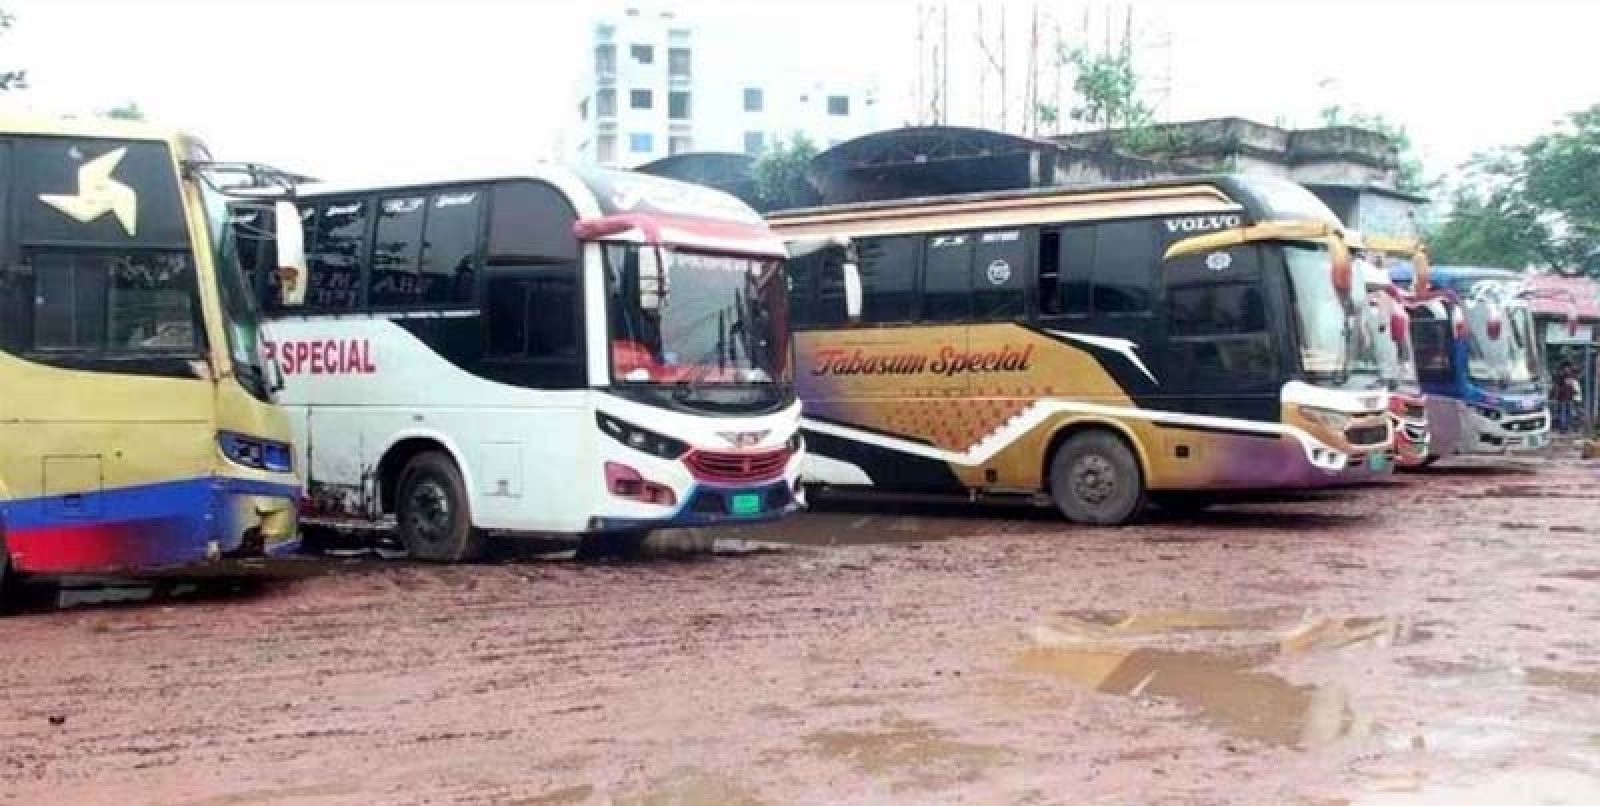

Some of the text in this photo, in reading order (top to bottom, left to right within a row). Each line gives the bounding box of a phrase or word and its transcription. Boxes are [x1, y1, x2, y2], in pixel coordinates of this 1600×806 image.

[1164, 214, 1241, 233] VOLVO
[281, 339, 377, 374] SPECIAL
[811, 343, 1034, 376] Tabasum Special
